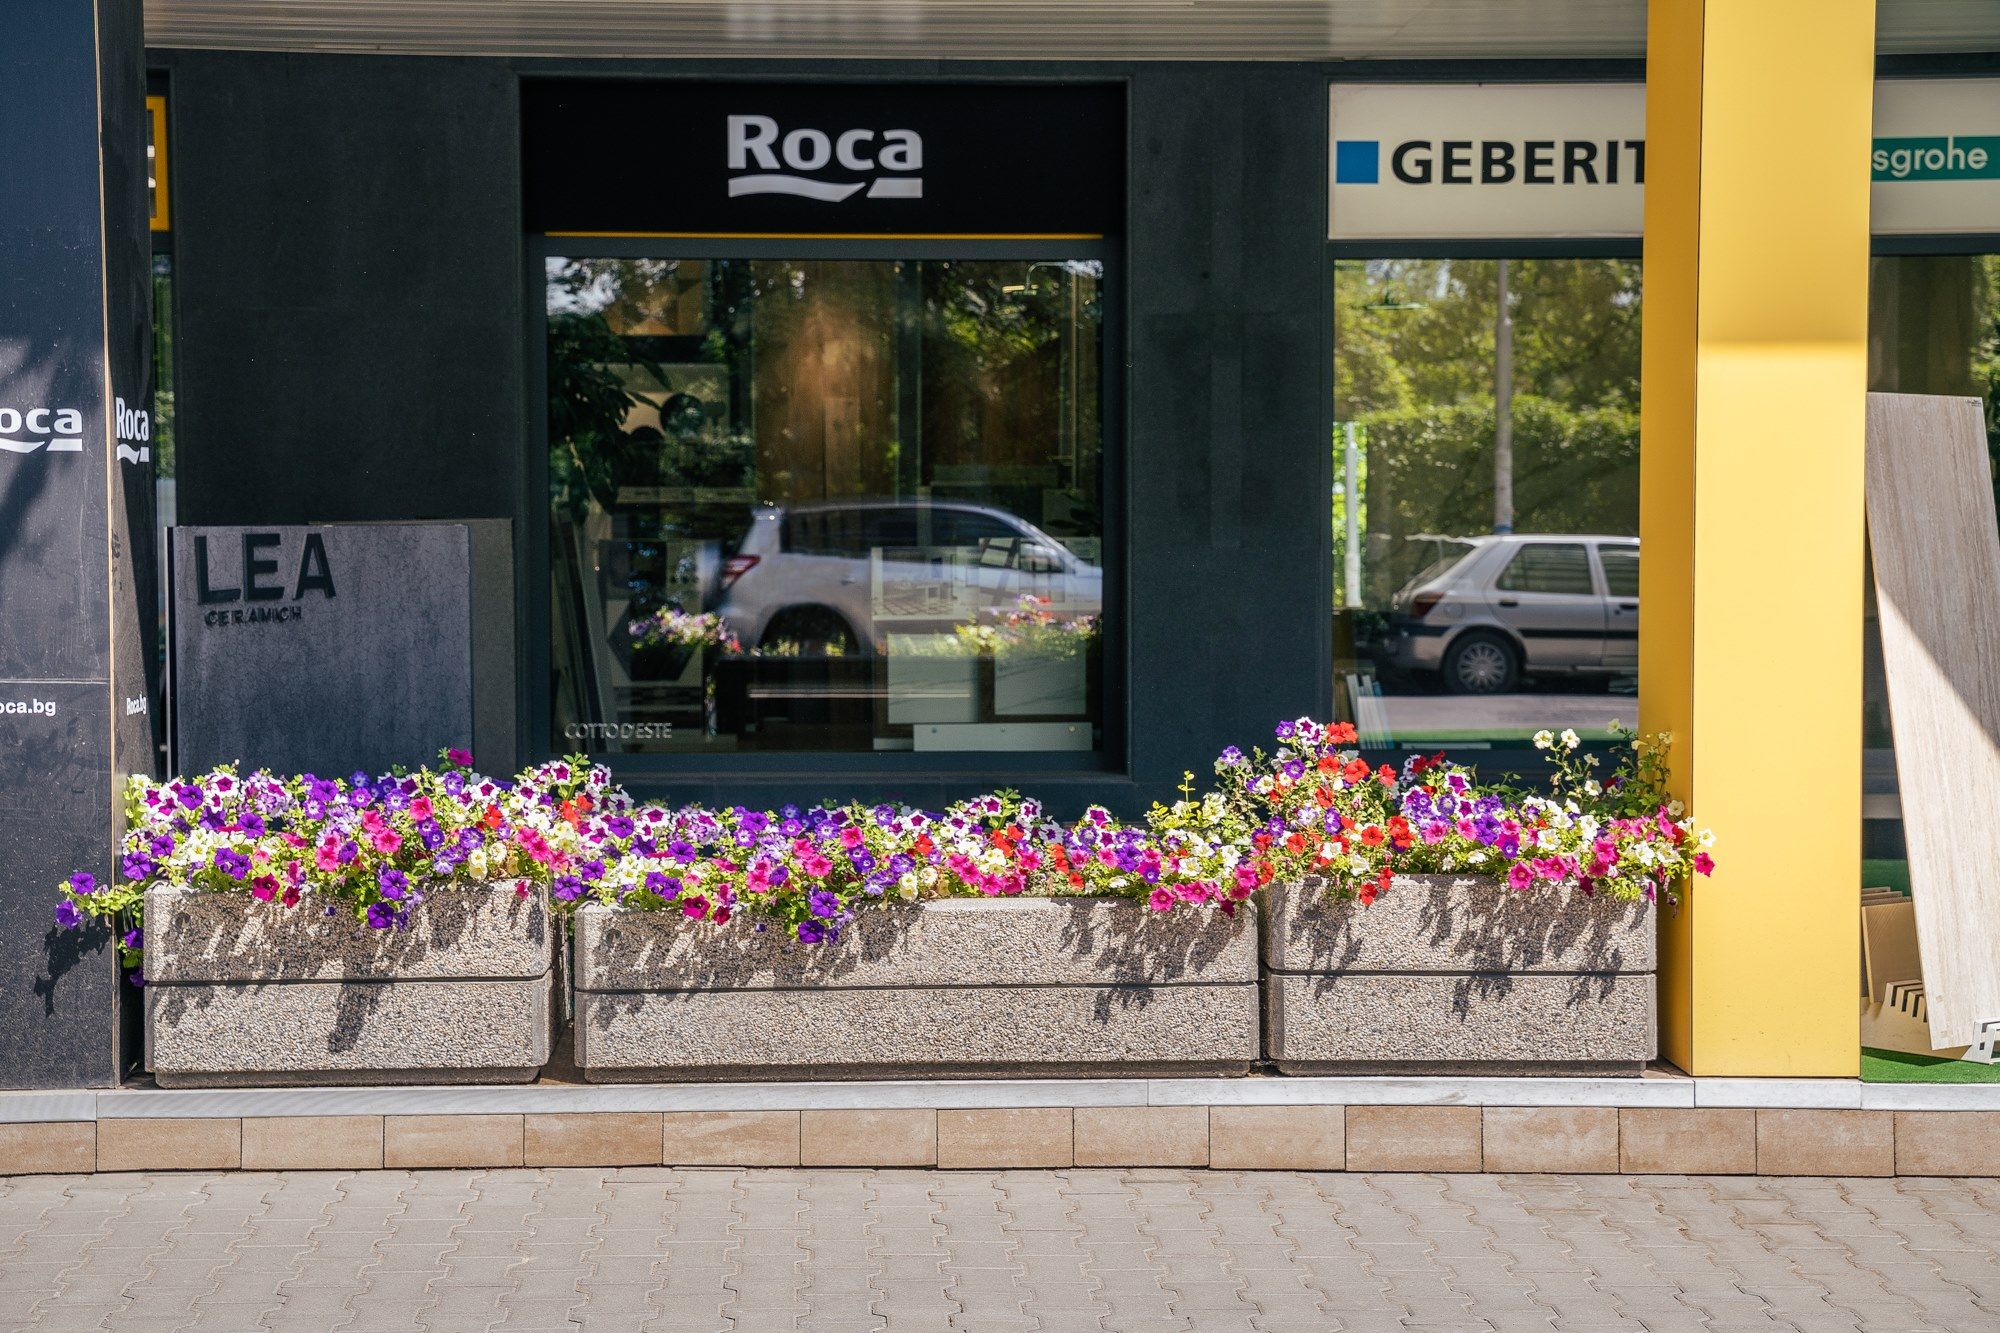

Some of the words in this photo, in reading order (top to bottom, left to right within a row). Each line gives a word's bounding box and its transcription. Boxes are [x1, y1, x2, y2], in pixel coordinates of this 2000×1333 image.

[727, 114, 924, 171] Roca
[1391, 140, 1646, 184] GEBERIT
[1872, 135, 1989, 179] sgrohe
[115, 396, 150, 442] Roca
[194, 533, 337, 605] LEA
